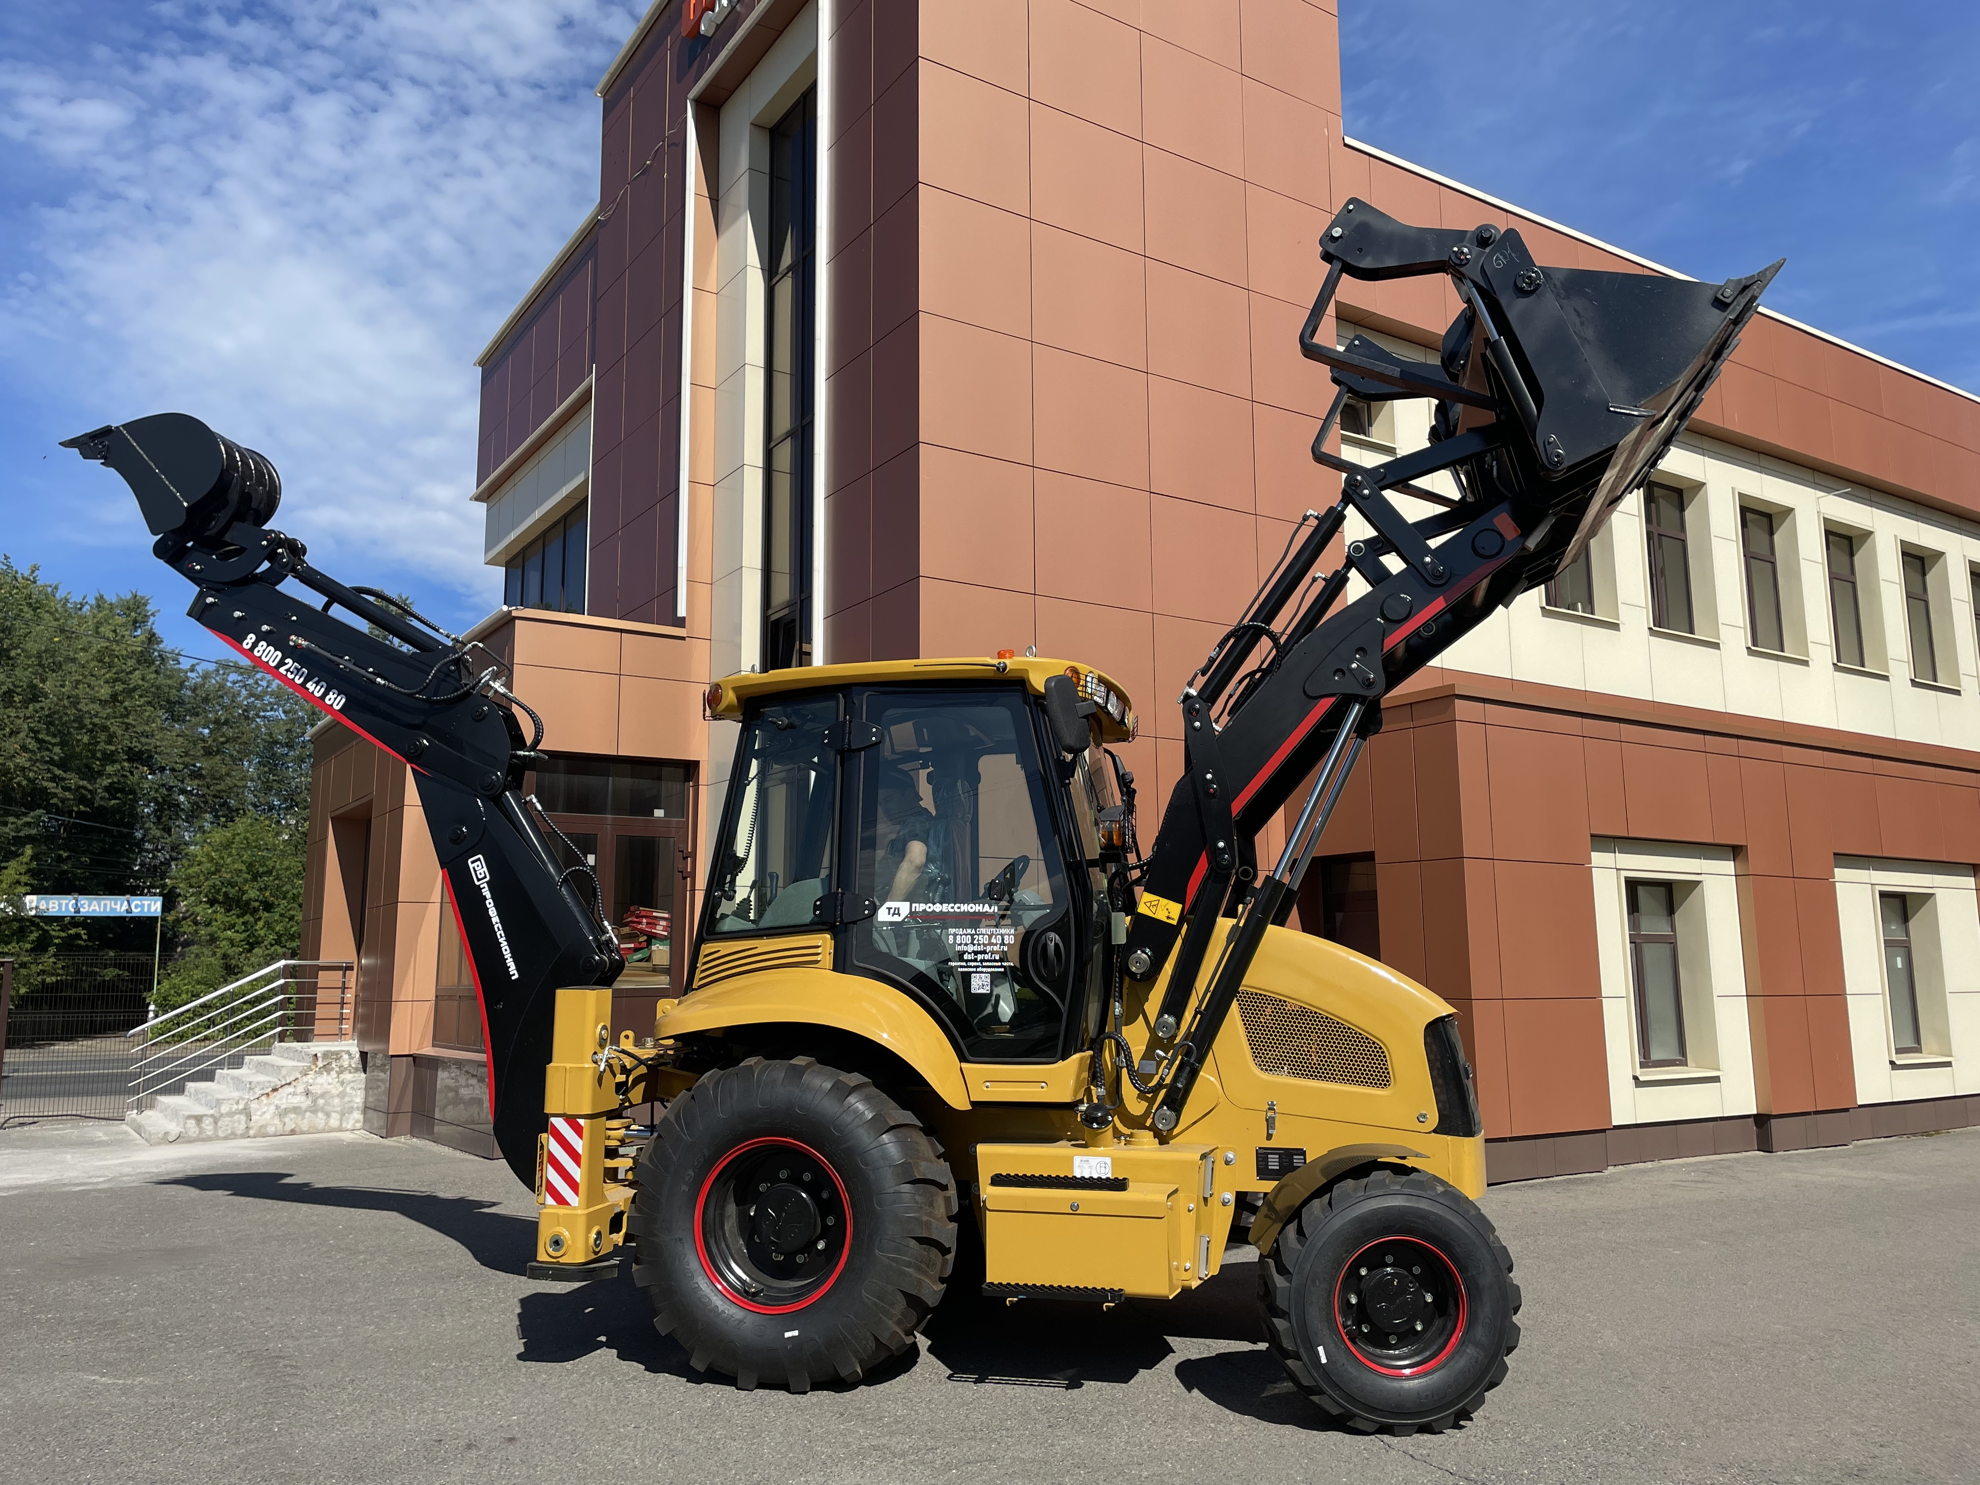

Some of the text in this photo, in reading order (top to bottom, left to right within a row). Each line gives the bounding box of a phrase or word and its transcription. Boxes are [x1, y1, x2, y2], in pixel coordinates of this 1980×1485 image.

[242, 633, 346, 711] 8 800 250 40 80
[39, 900, 161, 912] АВТОЗАПЧАСТИ
[885, 902, 998, 917] ТД ПРОФЕССИОНАЛ
[480, 881, 519, 981] ПРОФЕССИОНАЛ
[948, 935, 1015, 944] 8 800 250 40 80
[955, 943, 1008, 953] info@dst-prof.ru
[963, 952, 1000, 961] dst-prof.ru
